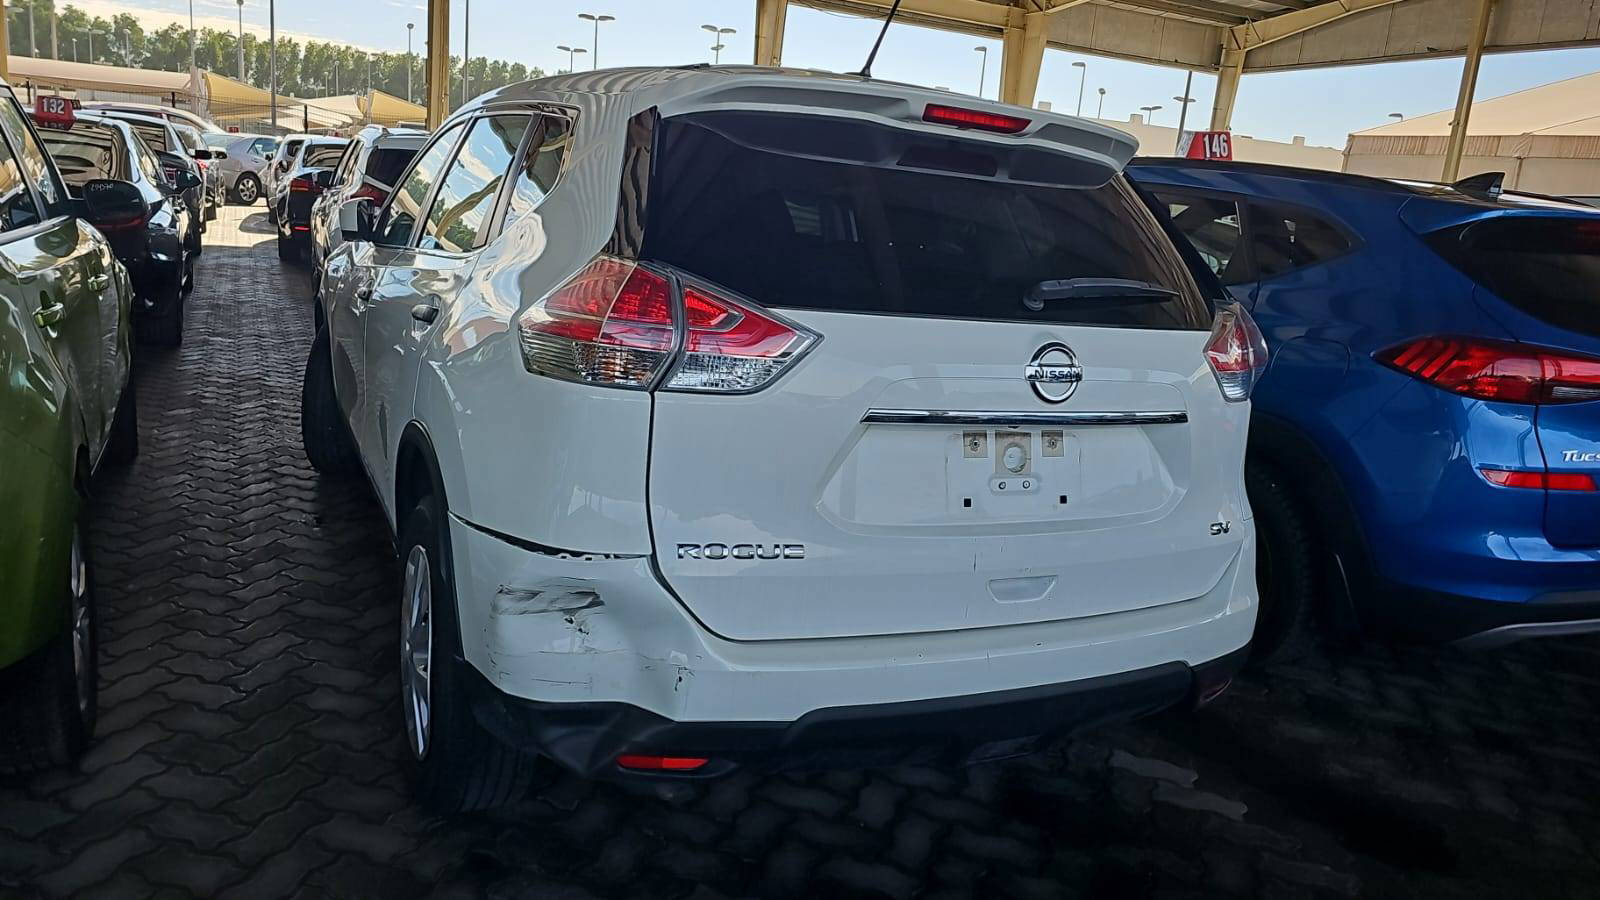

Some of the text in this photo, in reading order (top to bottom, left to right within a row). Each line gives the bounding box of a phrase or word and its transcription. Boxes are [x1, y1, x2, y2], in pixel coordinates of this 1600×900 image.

[42, 97, 65, 114] 132
[1203, 133, 1228, 158] 146
[1034, 369, 1080, 379] NISSAN
[1210, 521, 1231, 536] SV
[676, 543, 806, 560] ROGUE
